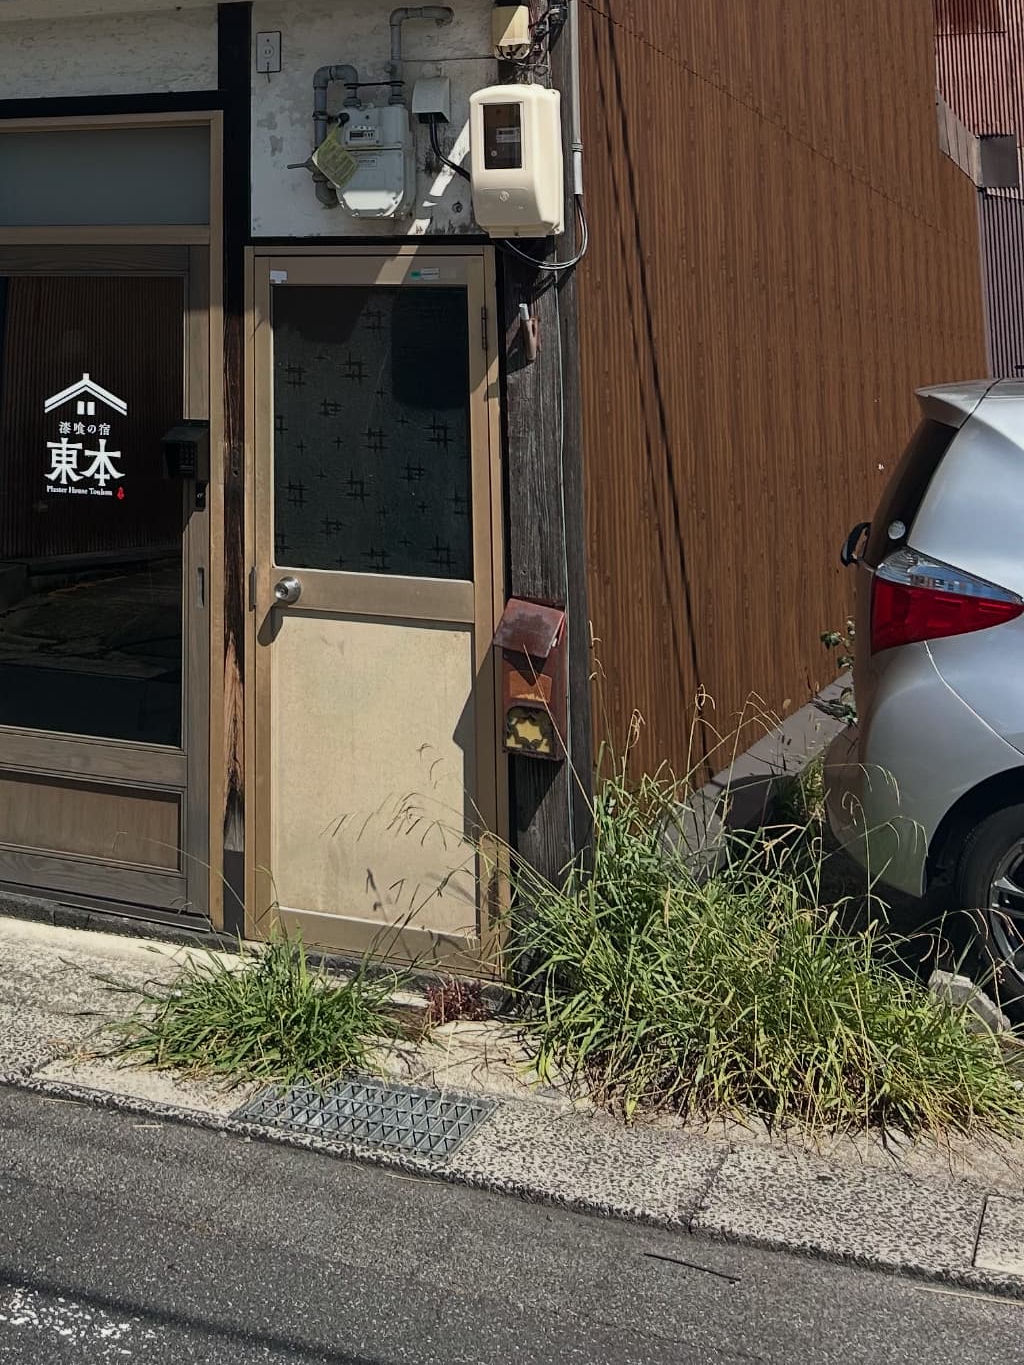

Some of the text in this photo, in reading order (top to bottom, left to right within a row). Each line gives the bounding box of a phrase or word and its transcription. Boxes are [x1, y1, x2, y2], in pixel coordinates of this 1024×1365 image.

[58, 421, 111, 436] 漆喰の宿
[44, 437, 126, 486] 東本
[68, 486, 88, 494] House
